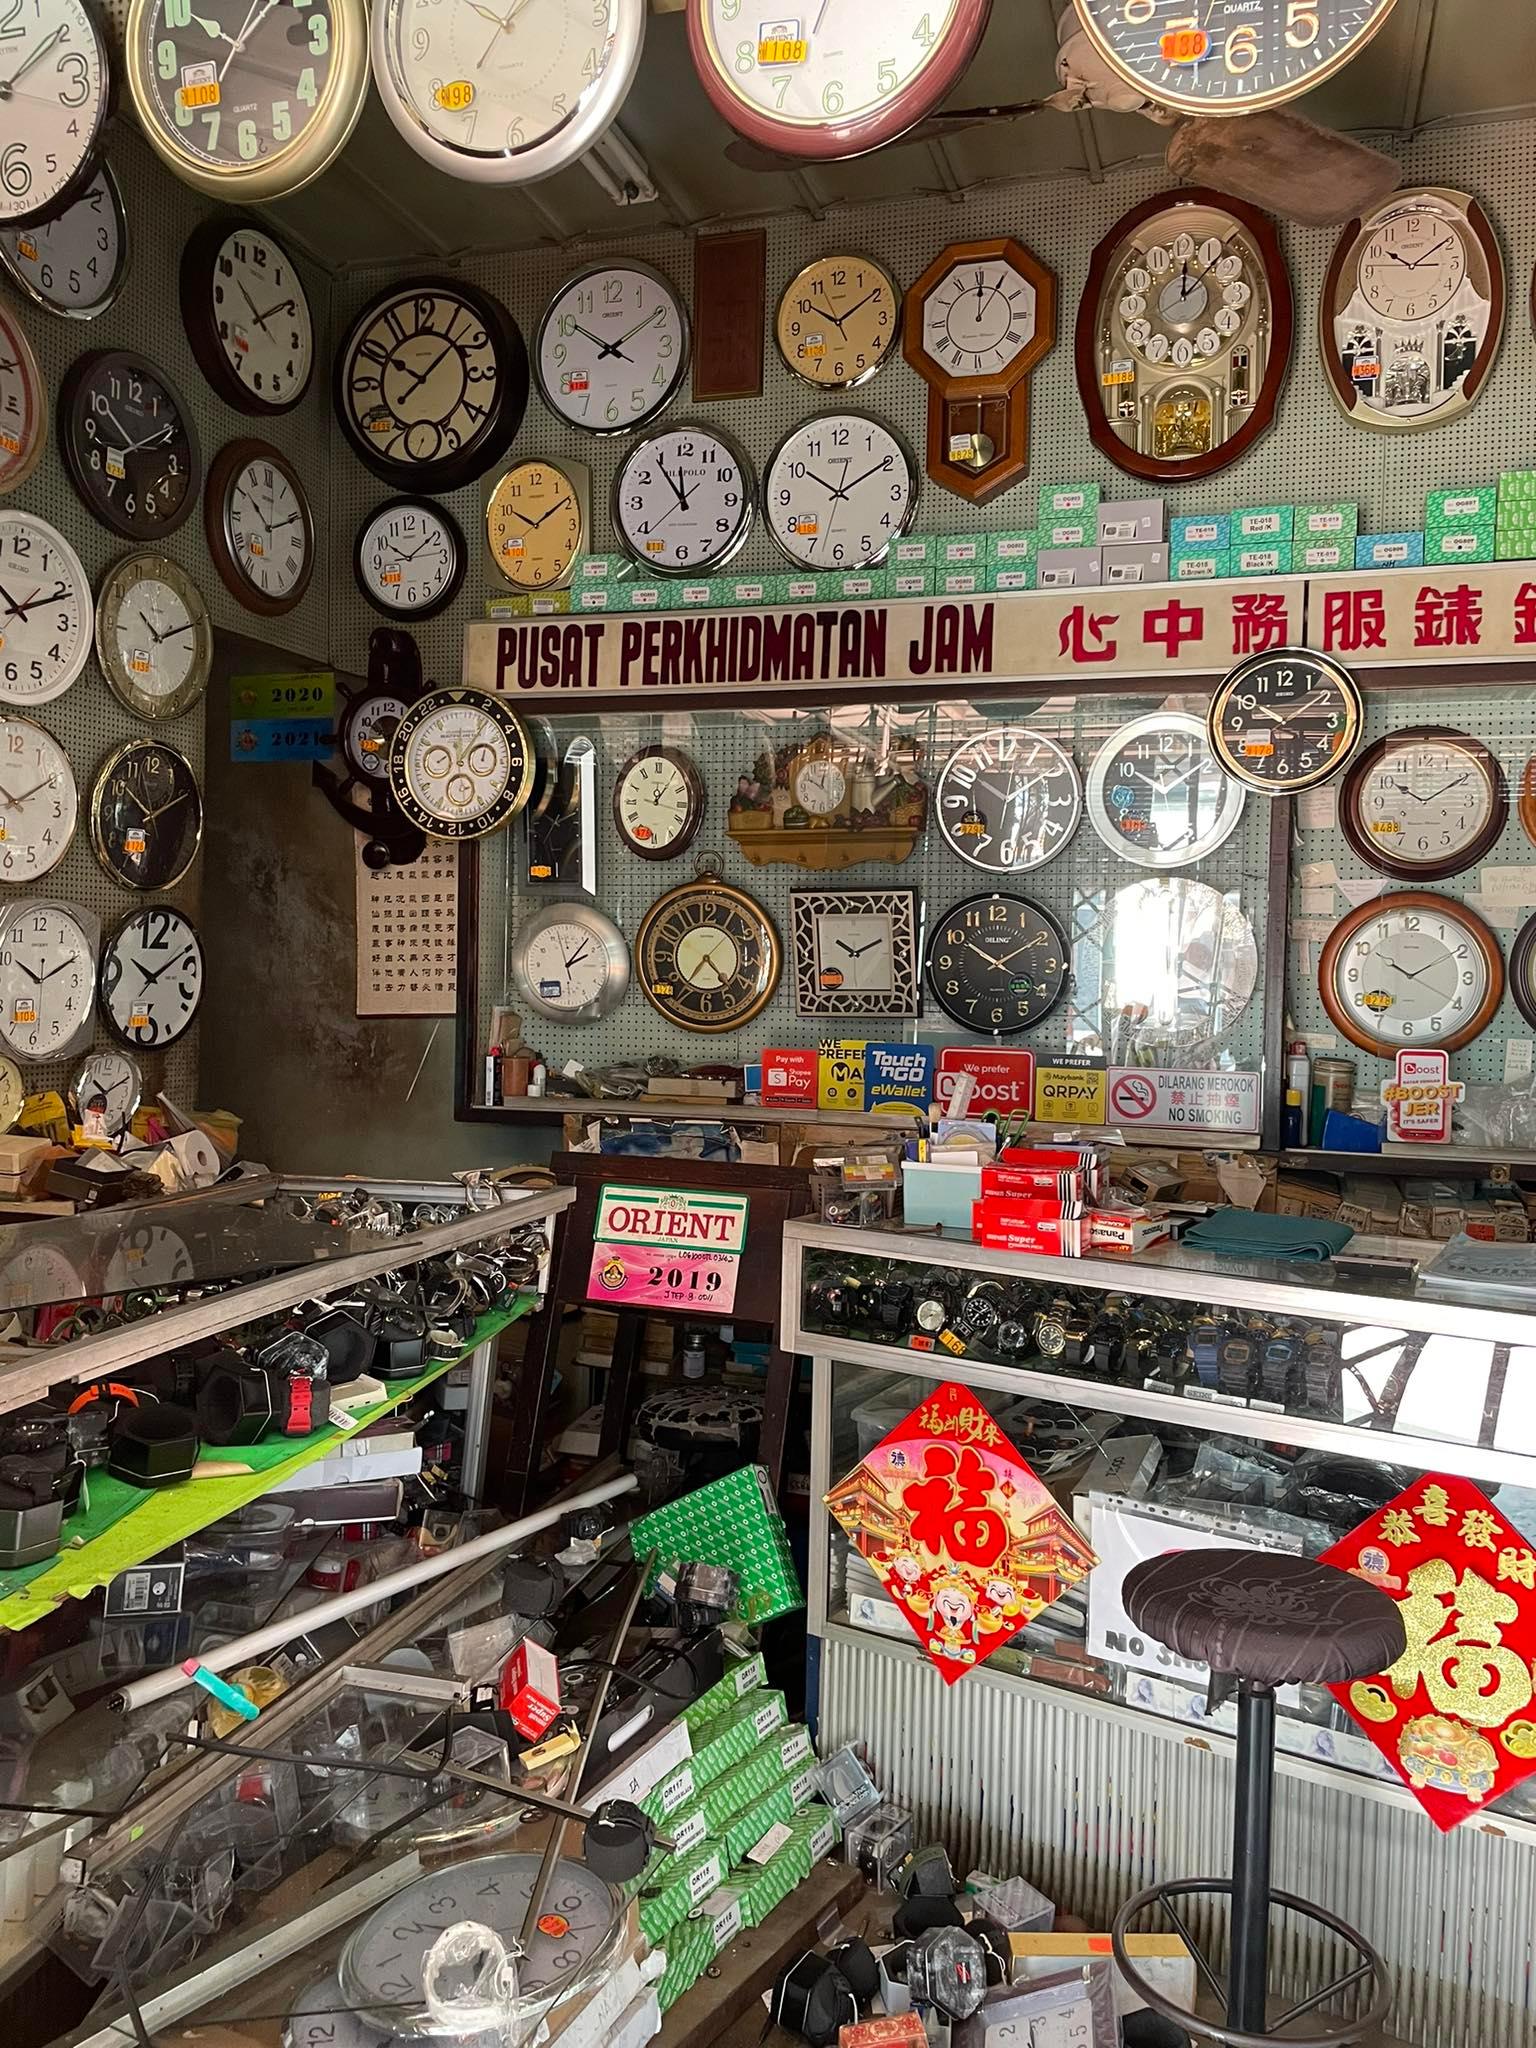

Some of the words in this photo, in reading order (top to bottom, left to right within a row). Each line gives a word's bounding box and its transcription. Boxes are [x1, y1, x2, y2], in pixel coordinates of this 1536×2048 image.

[1224, 3, 1263, 14] QUARTZ
[912, 13, 935, 47] 4
[1285, 2, 1319, 48] 5
[308, 15, 328, 56] 3
[412, 27, 430, 61] 9
[735, 40, 755, 74] 8
[1224, 26, 1258, 74] 6
[157, 40, 177, 80] 9
[56, 52, 90, 108] 3
[877, 59, 898, 94] 5
[296, 68, 316, 107] 4
[772, 75, 792, 108] 7
[822, 80, 844, 114] 6
[233, 103, 258, 113] QUARTZ
[66, 119, 79, 137] 4
[272, 101, 292, 141] 5
[463, 111, 478, 144] 7
[202, 111, 221, 151] 7
[237, 119, 257, 160] 6
[507, 117, 525, 147] 6
[1, 143, 32, 197] 6
[46, 154, 57, 173] 5
[830, 271, 846, 286] 12
[602, 279, 623, 304] 12
[577, 289, 593, 314] 11
[657, 334, 673, 358] 3
[630, 388, 646, 412] 5
[831, 429, 850, 446] 12
[676, 442, 694, 458] 12
[807, 440, 822, 457] 11
[716, 467, 733, 482] 10
[788, 462, 806, 479] 10
[724, 493, 738, 507] 9
[780, 489, 791, 506] 9
[890, 484, 902, 501] 3
[13, 535, 31, 558] 12
[675, 546, 688, 560] 6
[832, 544, 844, 560] 6
[56, 613, 69, 632] 3
[497, 623, 604, 690] PUSAT
[620, 608, 887, 687] PERKHIDMATAN
[910, 603, 994, 673] JAM
[30, 660, 43, 680] 5
[1276, 670, 1294, 687] 12
[272, 687, 323, 702] 2020
[418, 698, 437, 716] 22
[398, 721, 414, 741] 20
[700, 902, 718, 924] 12
[988, 904, 1008, 922] 12
[138, 911, 170, 950] 12
[1404, 916, 1421, 932] 12
[820, 1039, 841, 1048] WE
[776, 1055, 789, 1064] Pay
[791, 1055, 804, 1063] with
[872, 1050, 926, 1067] Touch
[1064, 1058, 1091, 1066] PREFER
[963, 1063, 980, 1073] We
[981, 1065, 1010, 1074] prefer
[1052, 1073, 1084, 1082] Maybank
[788, 1075, 811, 1090] Pay
[871, 1085, 926, 1097] eWallet
[1158, 1075, 1205, 1091] DILARANG
[1207, 1076, 1254, 1092] MEROKOK
[1043, 1084, 1097, 1100] QRPAY
[1384, 1084, 1463, 1102] #BOOST
[1168, 1108, 1185, 1122] NO
[1188, 1108, 1241, 1124] SMOKING
[1404, 1102, 1440, 1117] JER
[1005, 1190, 1032, 1198] Super
[608, 1206, 735, 1241] ORIENT
[1007, 1234, 1036, 1244] Super
[647, 1266, 721, 1292] 2019
[1105, 1630, 1144, 1654] NO
[664, 1779, 683, 1798] OR117
